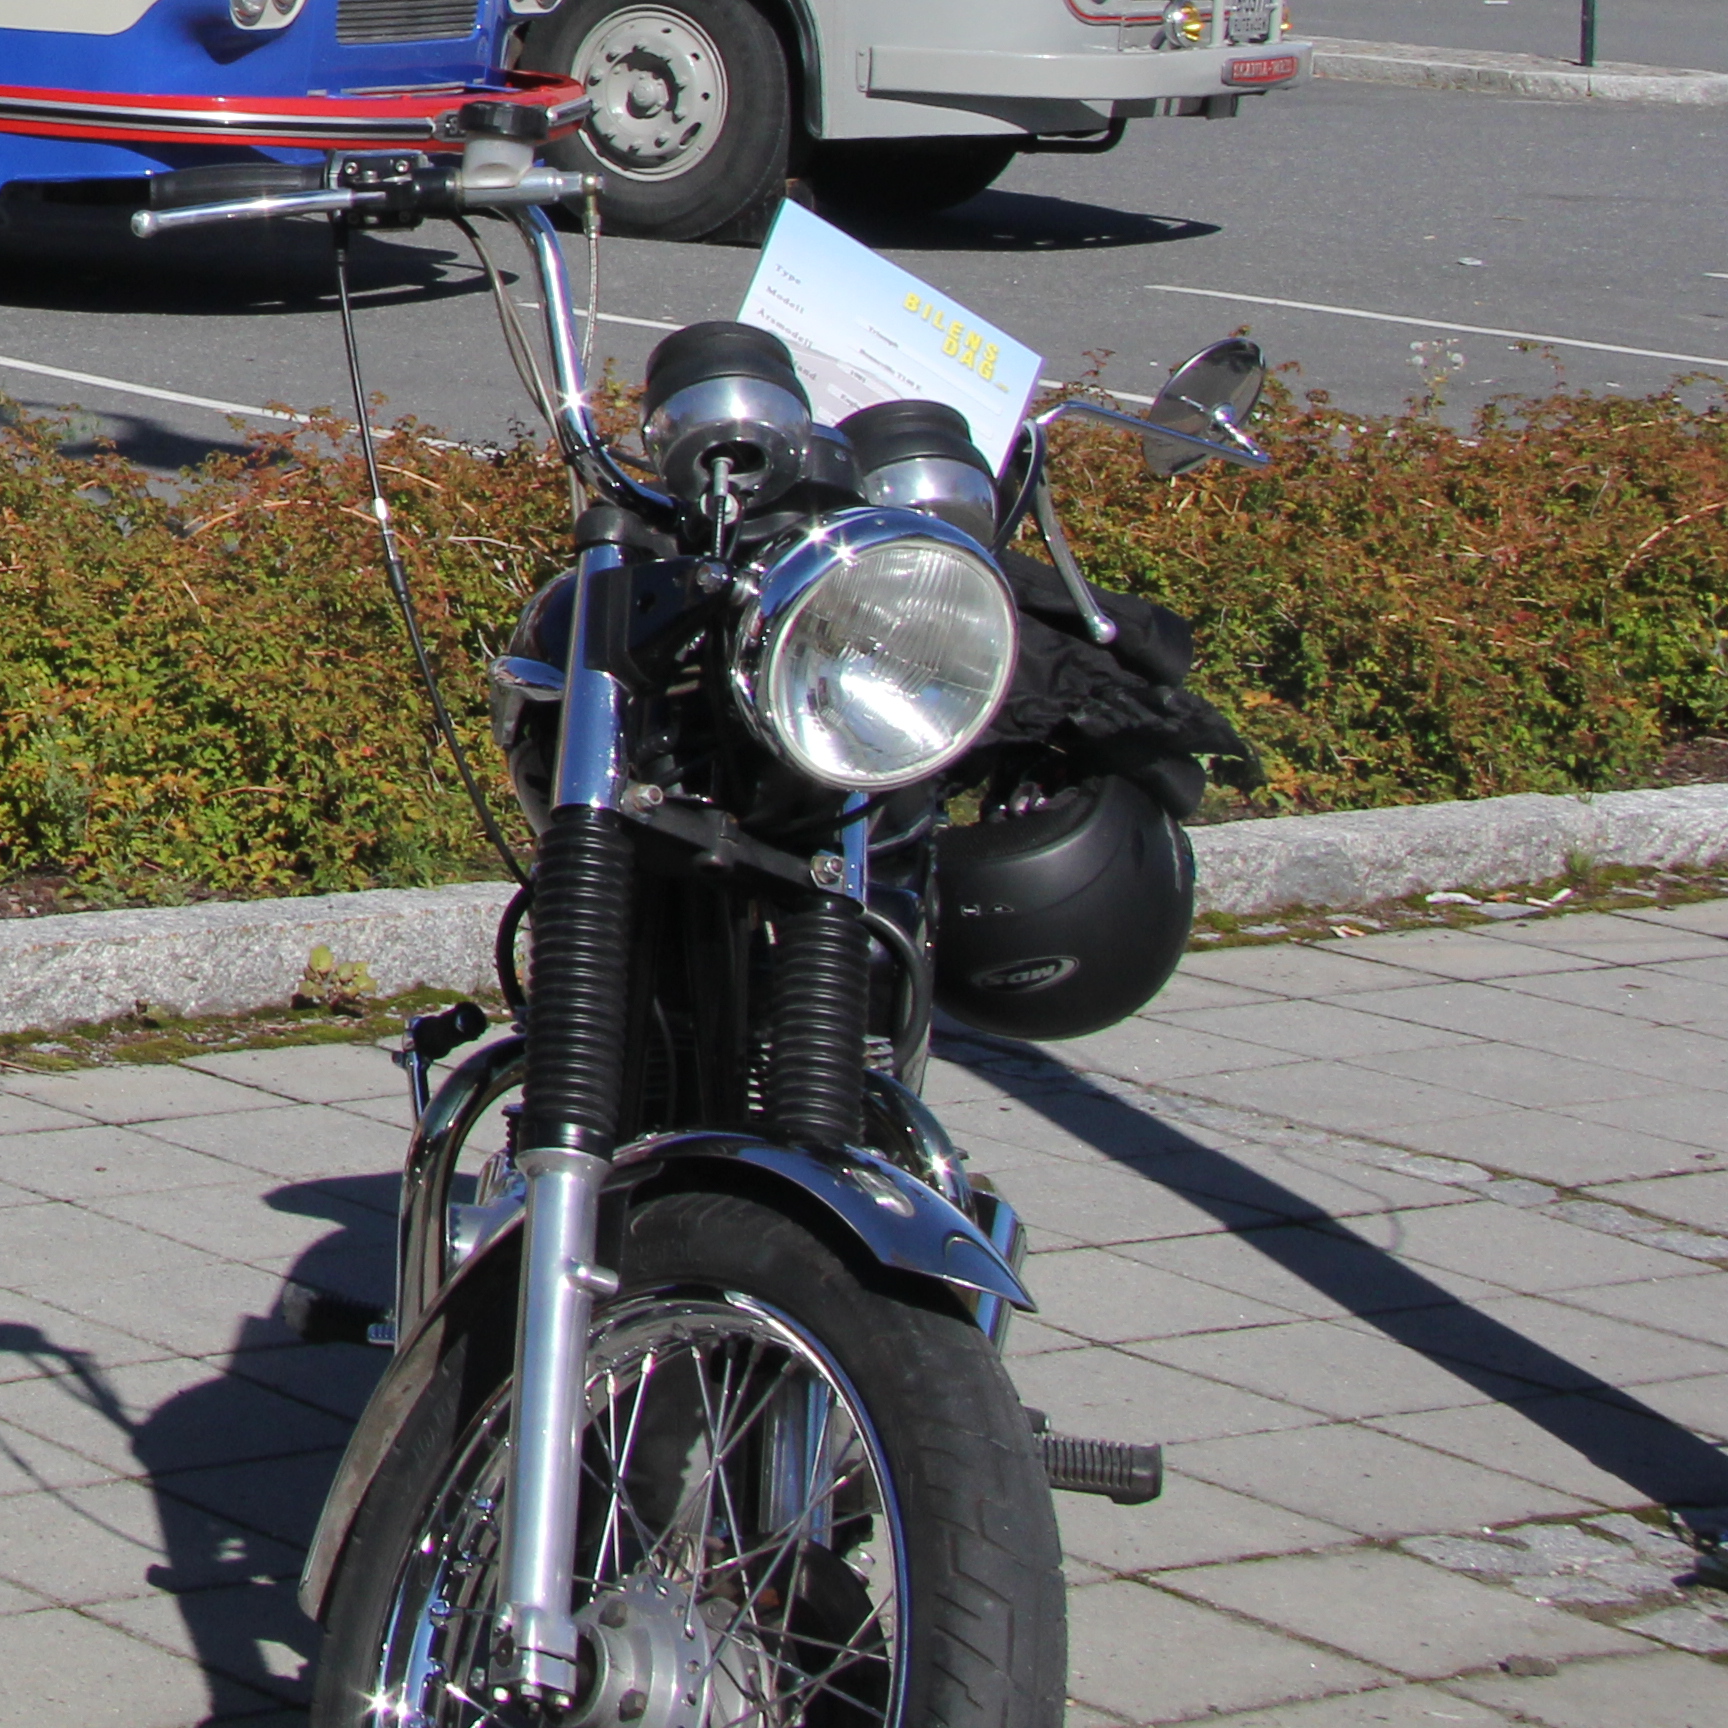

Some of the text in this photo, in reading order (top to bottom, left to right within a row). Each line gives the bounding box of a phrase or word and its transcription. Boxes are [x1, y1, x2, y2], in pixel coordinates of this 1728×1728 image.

[775, 262, 802, 285] Type
[766, 285, 805, 314] Modell
[902, 291, 1000, 364] BILENS
[941, 334, 996, 382] DAG
